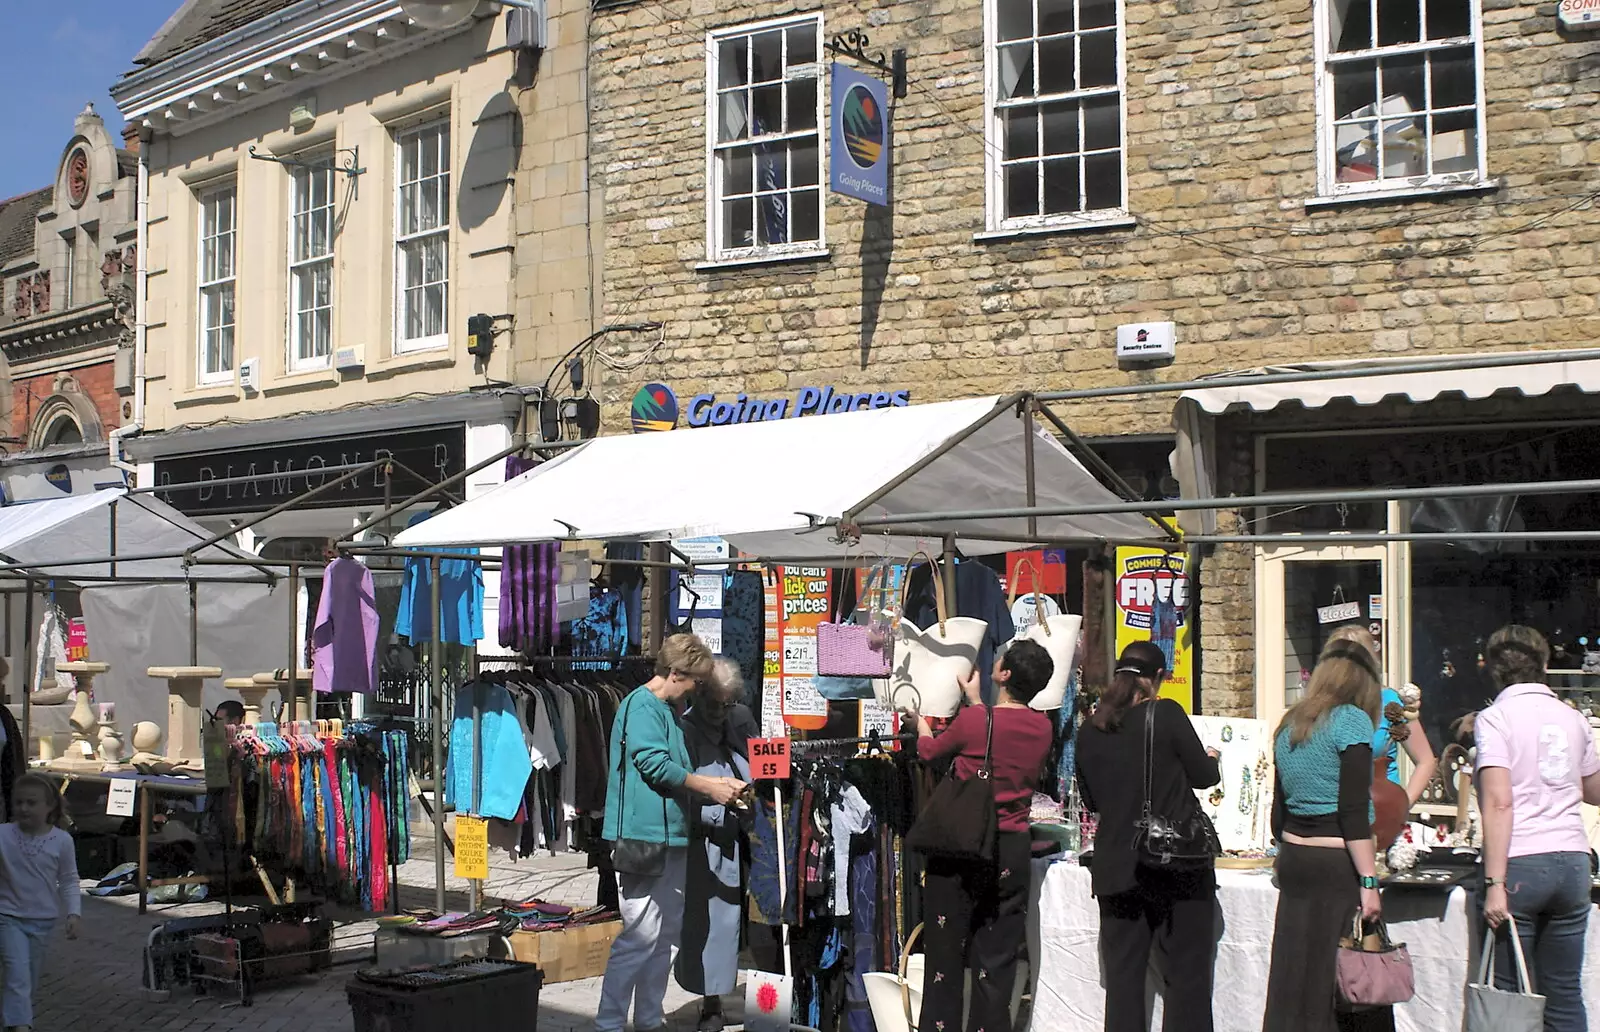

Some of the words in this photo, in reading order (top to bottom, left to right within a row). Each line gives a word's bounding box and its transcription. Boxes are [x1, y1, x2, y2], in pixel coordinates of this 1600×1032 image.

[839, 172, 860, 192] Going
[861, 179, 884, 196] Places
[687, 393, 788, 426] Going
[792, 385, 909, 416] Places
[199, 449, 394, 501] DIAMOND
[783, 577, 806, 595] lick
[808, 580, 828, 593] our
[783, 594, 828, 620] prices
[1320, 606, 1358, 621] Closed
[799, 625, 806, 633] of
[753, 743, 785, 756] SALE
[762, 763, 777, 775] £5
